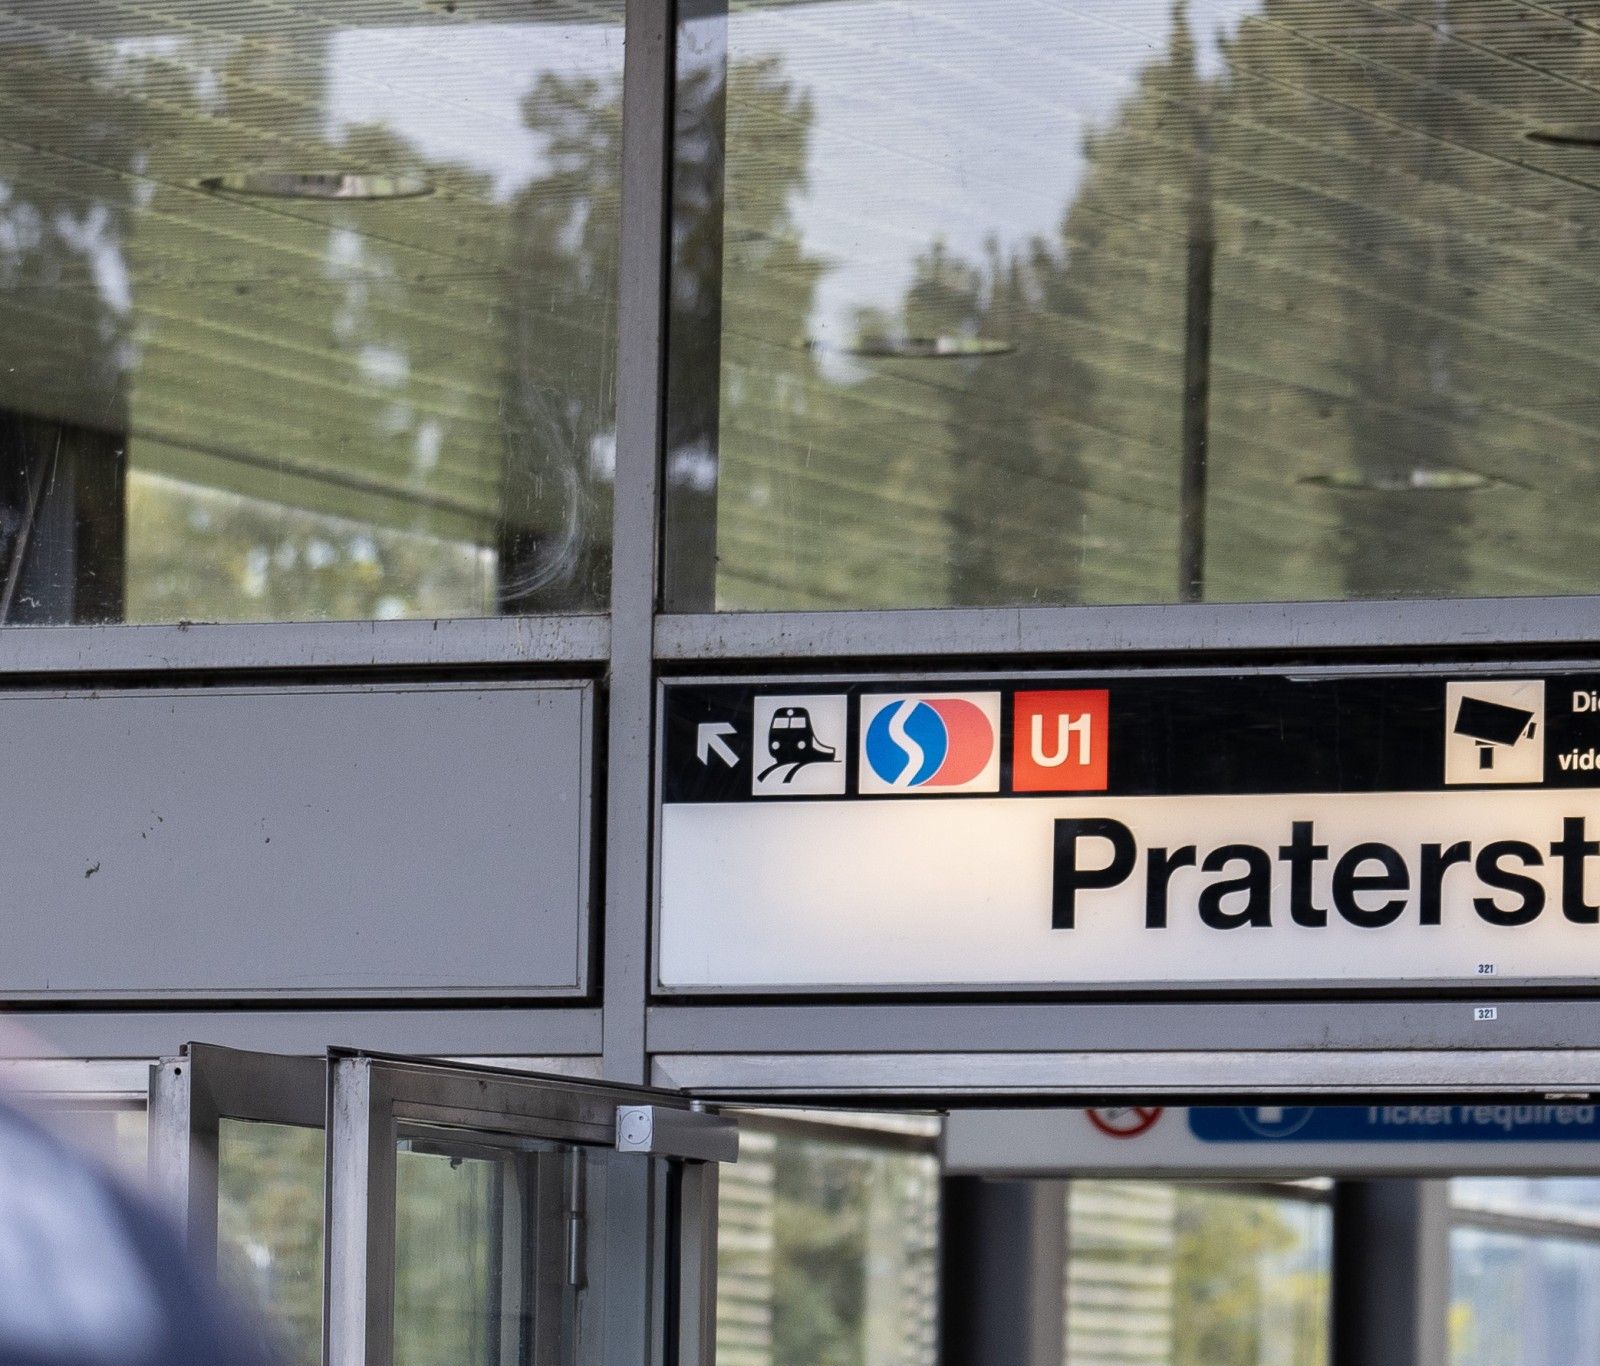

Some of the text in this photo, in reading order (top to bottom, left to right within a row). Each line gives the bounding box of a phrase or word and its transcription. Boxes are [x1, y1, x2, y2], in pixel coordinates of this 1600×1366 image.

[1573, 691, 1600, 712] Di
[1031, 713, 1091, 768] U1
[1051, 817, 1600, 930] Praterst
[1478, 964, 1494, 974] 321
[1478, 1009, 1494, 1019] 321
